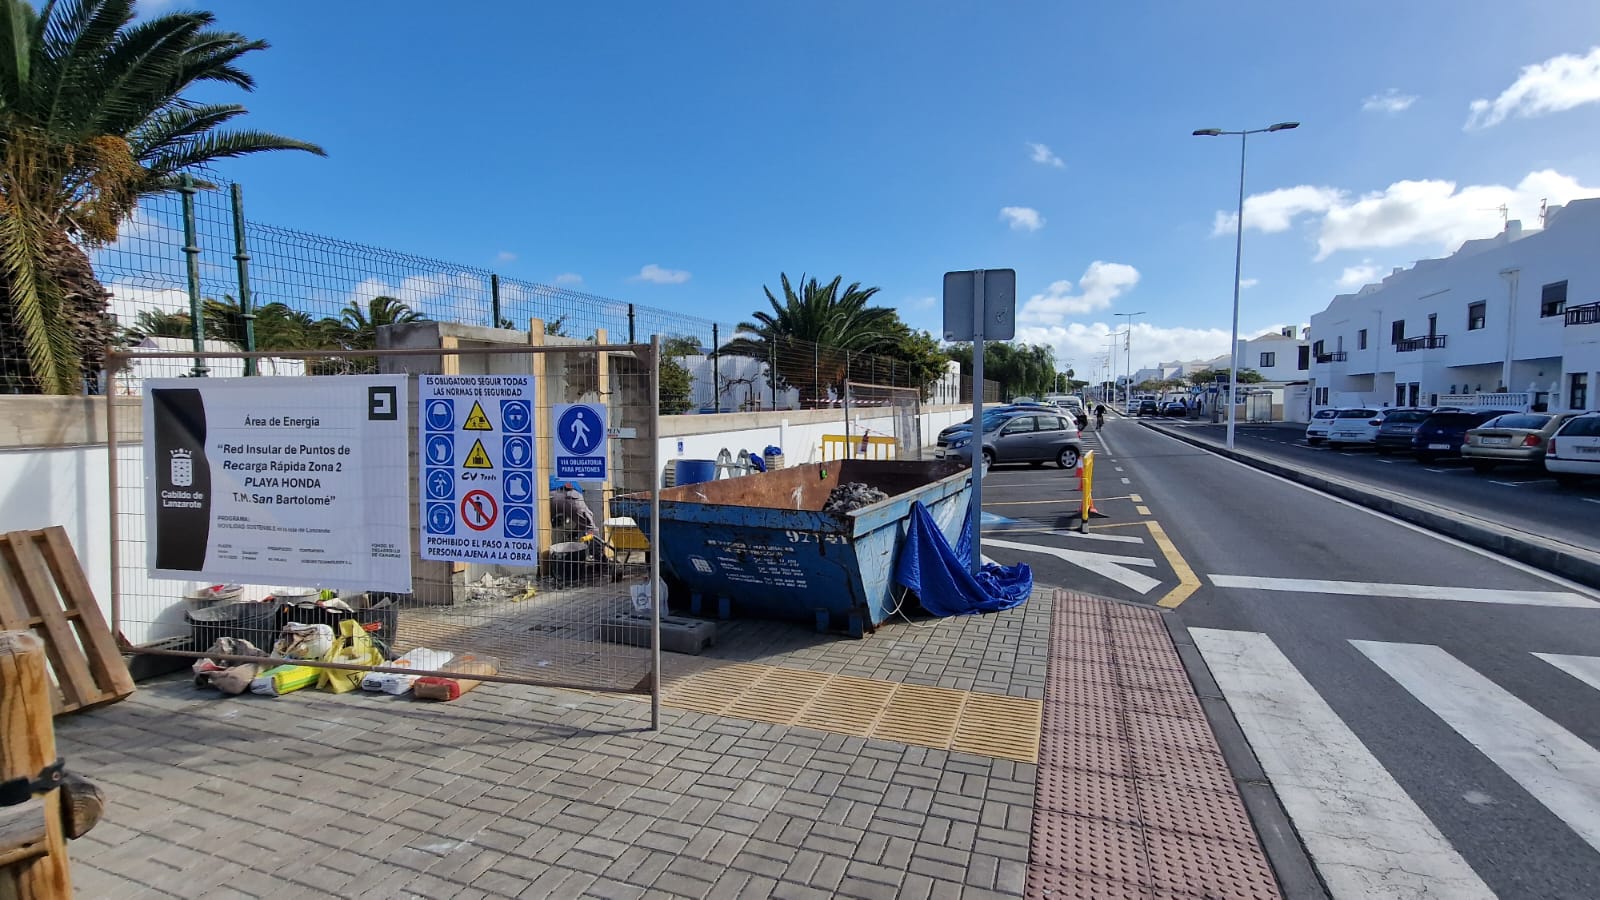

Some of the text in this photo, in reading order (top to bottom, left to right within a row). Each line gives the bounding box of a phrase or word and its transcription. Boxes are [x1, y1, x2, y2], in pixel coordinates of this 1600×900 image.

[426, 377, 528, 386] ES OBLIGATORIO SEGUIR TODAS
[434, 388, 522, 396] LAS NORMAS DE SEGURIDAD
[244, 414, 266, 426] Área
[269, 416, 281, 426] de
[246, 444, 282, 454] Insular
[284, 445, 297, 455] de
[300, 445, 335, 455] Puntos
[338, 445, 350, 455] de
[223, 460, 342, 473] Recarga Rápida Zona 2
[461, 472, 478, 481] CV
[244, 477, 321, 488] PLAYA HONDA
[161, 490, 204, 500] Cabildo de
[252, 494, 273, 504] San
[163, 500, 202, 509] Lanzarote
[427, 537, 470, 547] PROHIBIDO
[482, 540, 502, 549] PASO
[504, 541, 510, 549] A
[512, 542, 533, 550] TODA
[428, 548, 462, 557] PERSONA
[464, 550, 488, 559] AJENA
[498, 552, 507, 560] LA
[510, 552, 532, 561] OBRA
